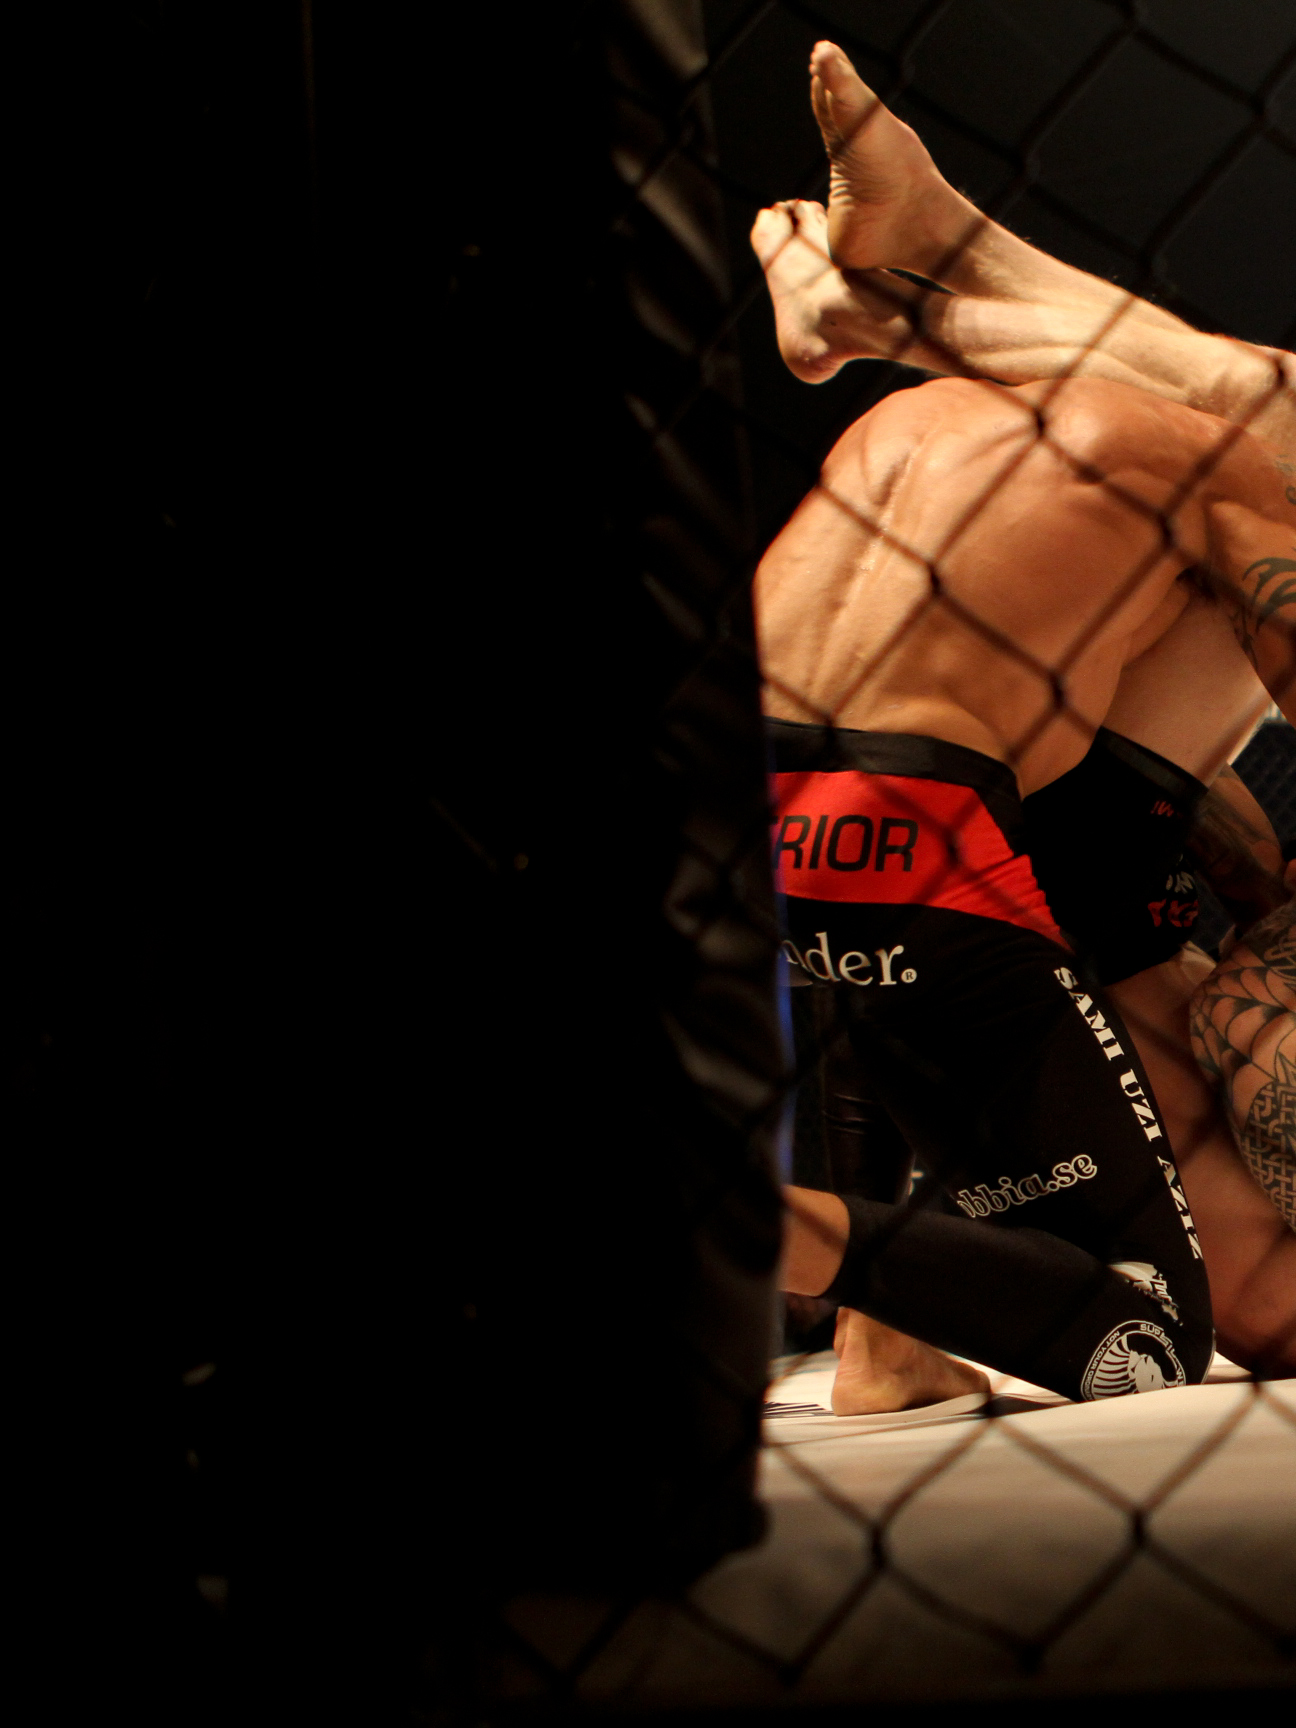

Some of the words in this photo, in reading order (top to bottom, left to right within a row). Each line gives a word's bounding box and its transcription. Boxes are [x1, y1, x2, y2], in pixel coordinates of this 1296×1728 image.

[1054, 967, 1125, 1061] SAMI
[1119, 1068, 1163, 1142] UZI
[1156, 1155, 1204, 1259] AZIZ
